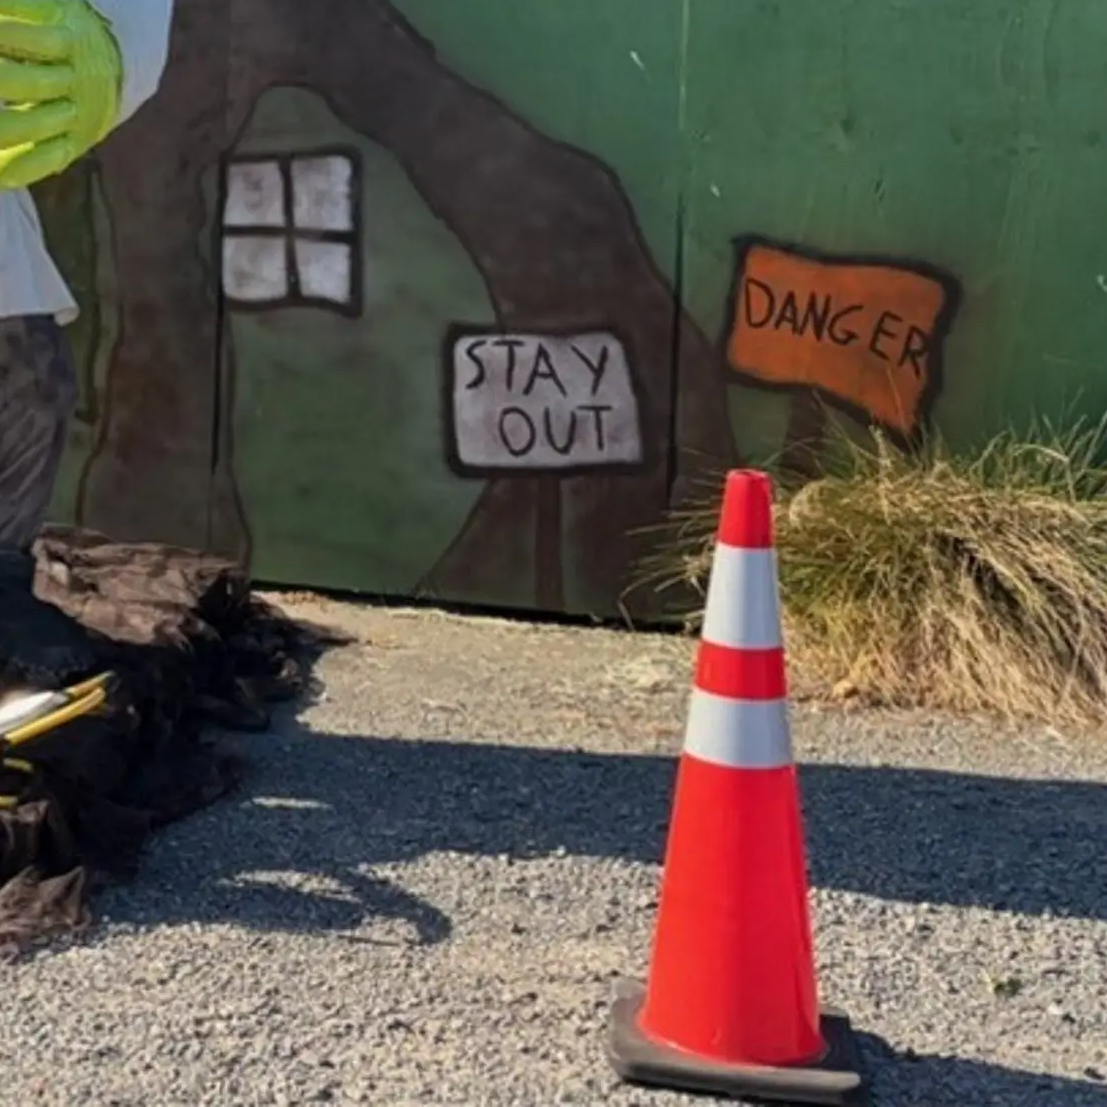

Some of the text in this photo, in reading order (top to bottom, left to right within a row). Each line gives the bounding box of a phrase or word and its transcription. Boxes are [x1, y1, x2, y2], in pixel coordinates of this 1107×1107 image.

[745, 277, 927, 380] DANGER
[465, 340, 609, 398] STAY
[498, 405, 613, 457] OUT
